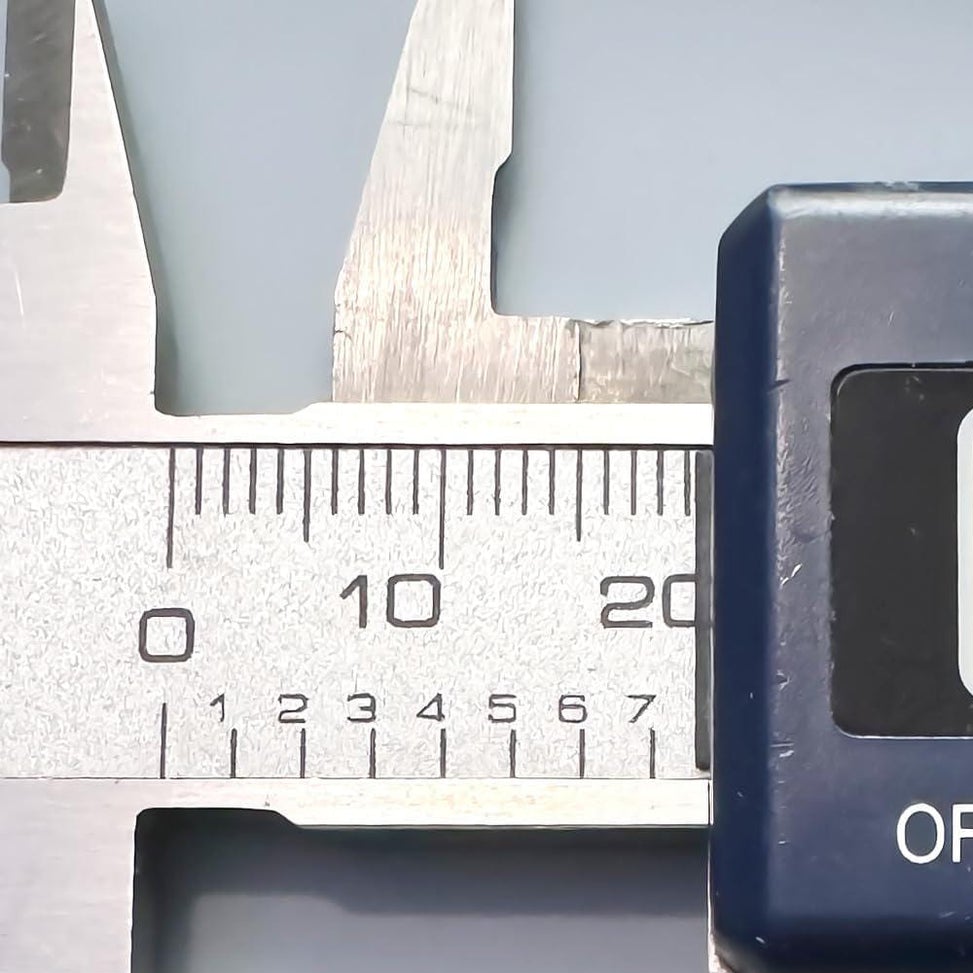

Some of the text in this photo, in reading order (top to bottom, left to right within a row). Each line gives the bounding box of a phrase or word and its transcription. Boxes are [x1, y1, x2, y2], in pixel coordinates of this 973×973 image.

[340, 573, 441, 629] 10
[139, 608, 195, 662] 0
[209, 693, 657, 724] 1 2 3 4 5 6 7
